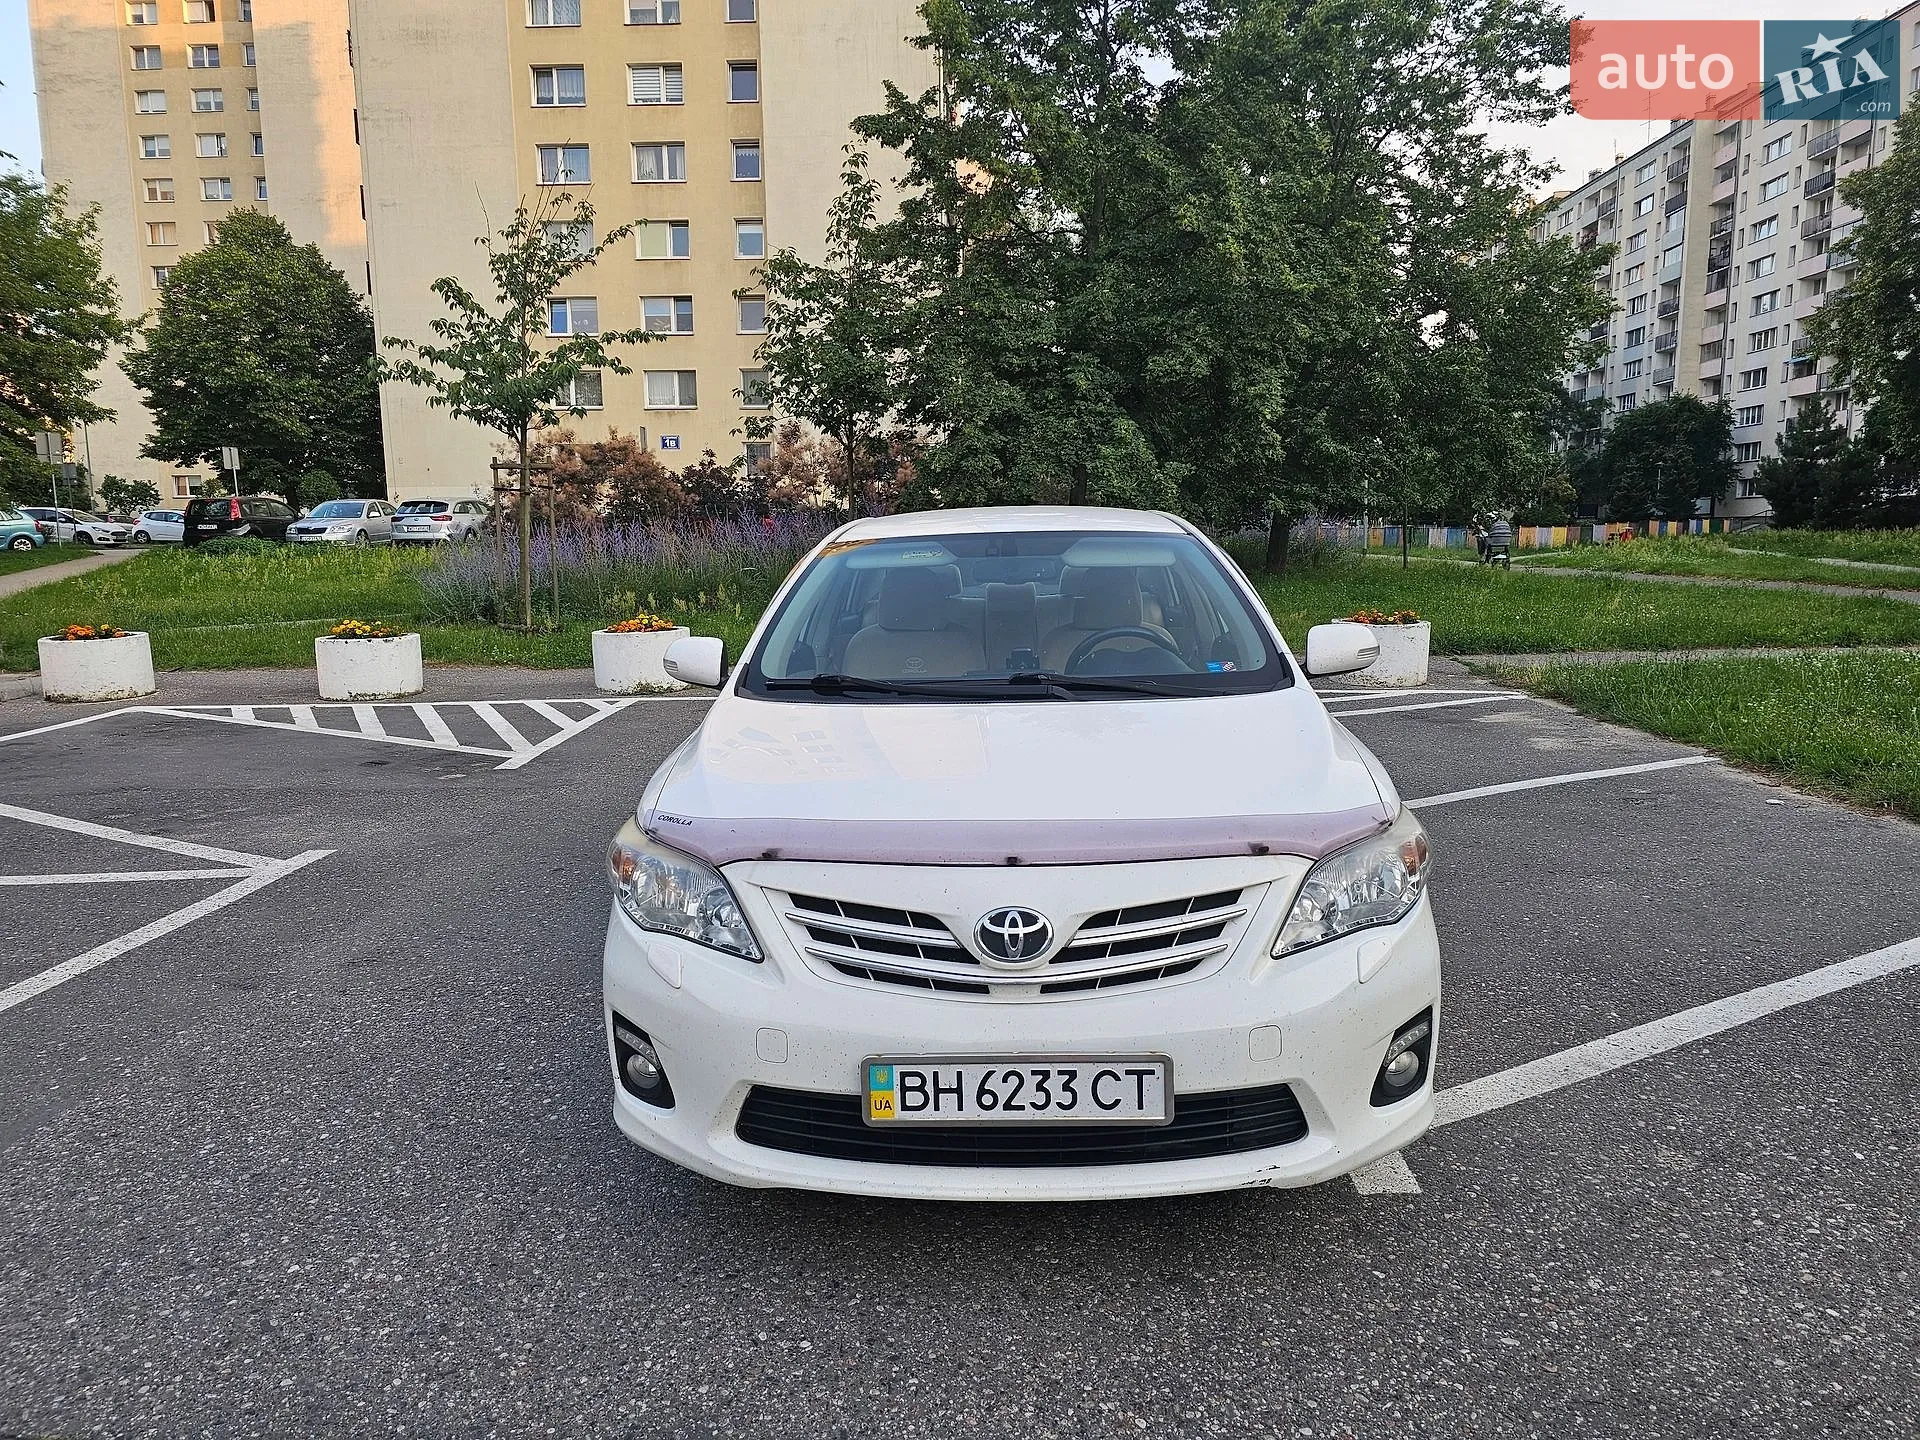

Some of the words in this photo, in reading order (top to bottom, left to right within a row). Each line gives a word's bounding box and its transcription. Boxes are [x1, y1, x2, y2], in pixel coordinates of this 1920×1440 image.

[657, 815, 692, 826] COROLLA
[899, 1070, 964, 1112] BH
[975, 1069, 1079, 1112] 6233
[1090, 1069, 1156, 1112] CT
[874, 1099, 893, 1111] UA
